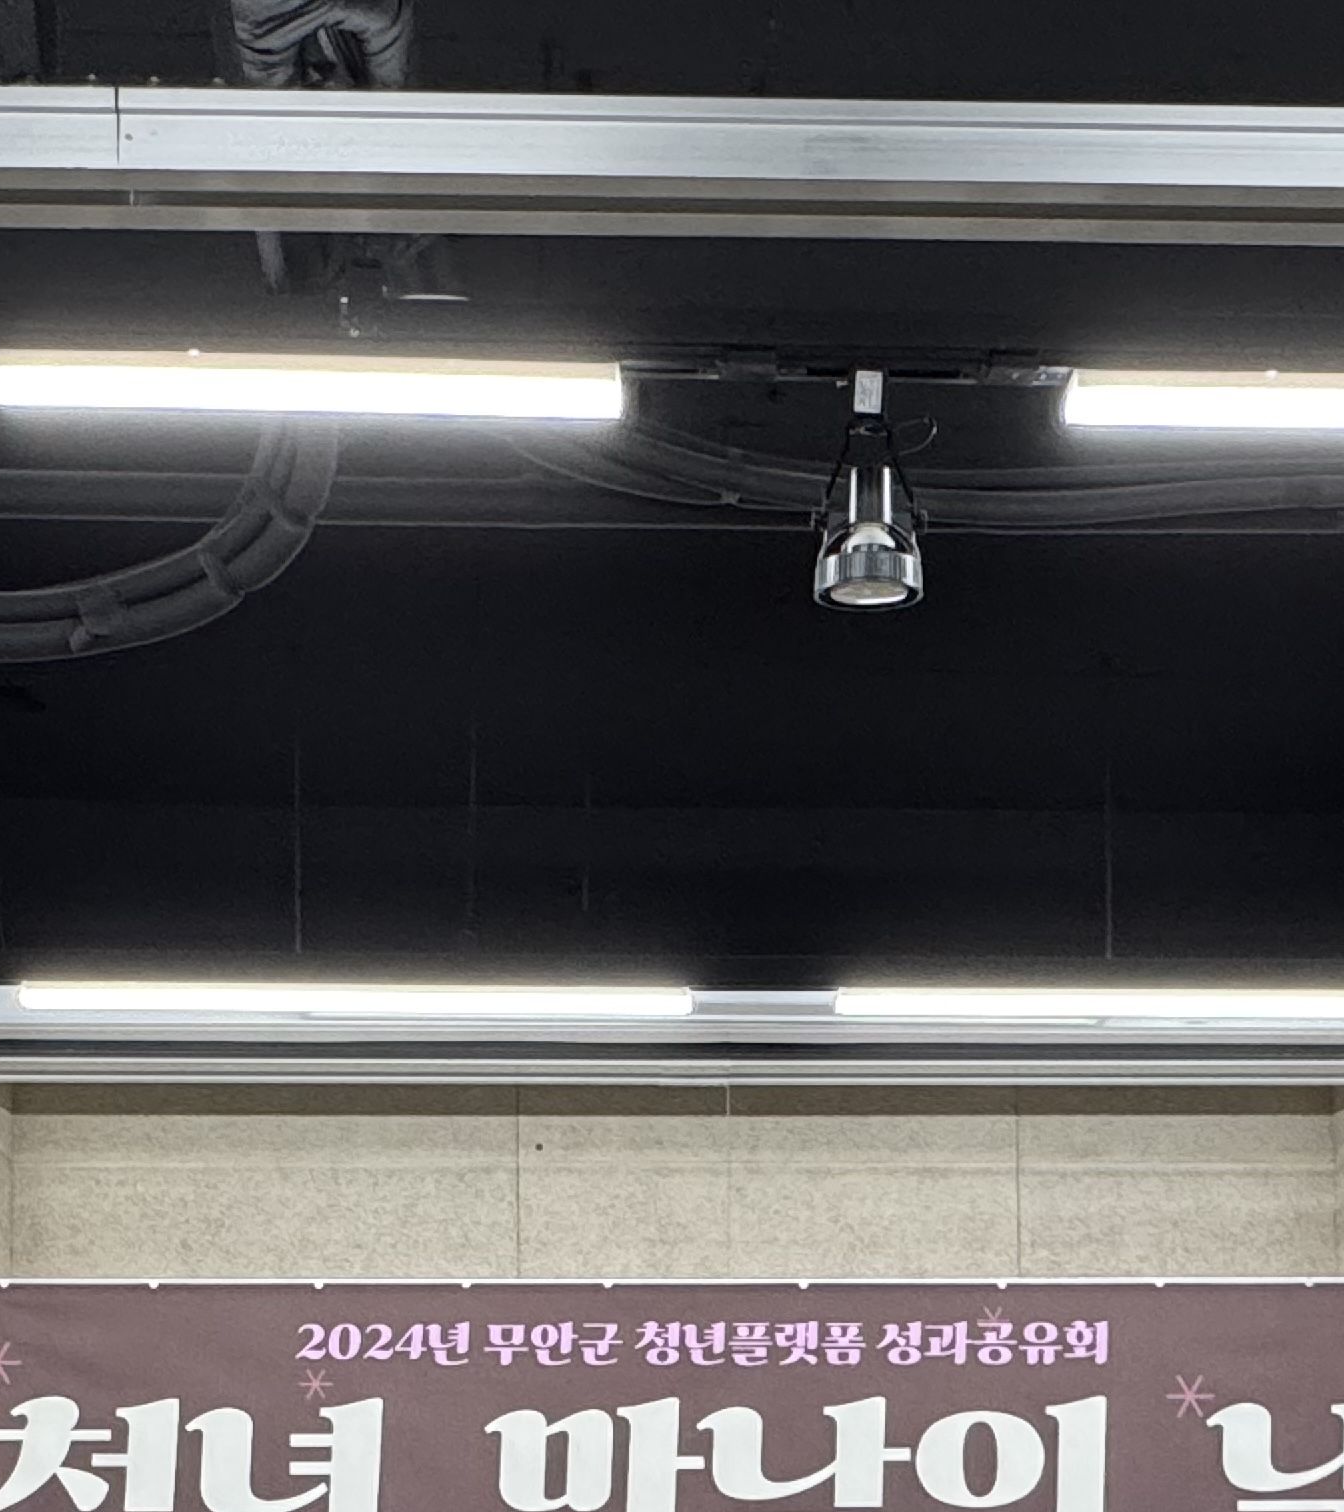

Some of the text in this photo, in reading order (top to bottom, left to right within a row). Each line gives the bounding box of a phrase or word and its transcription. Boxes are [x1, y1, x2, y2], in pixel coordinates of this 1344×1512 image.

[295, 1320, 1109, 1366] 2024년 무안군 청년플랫폼 성과공유회
